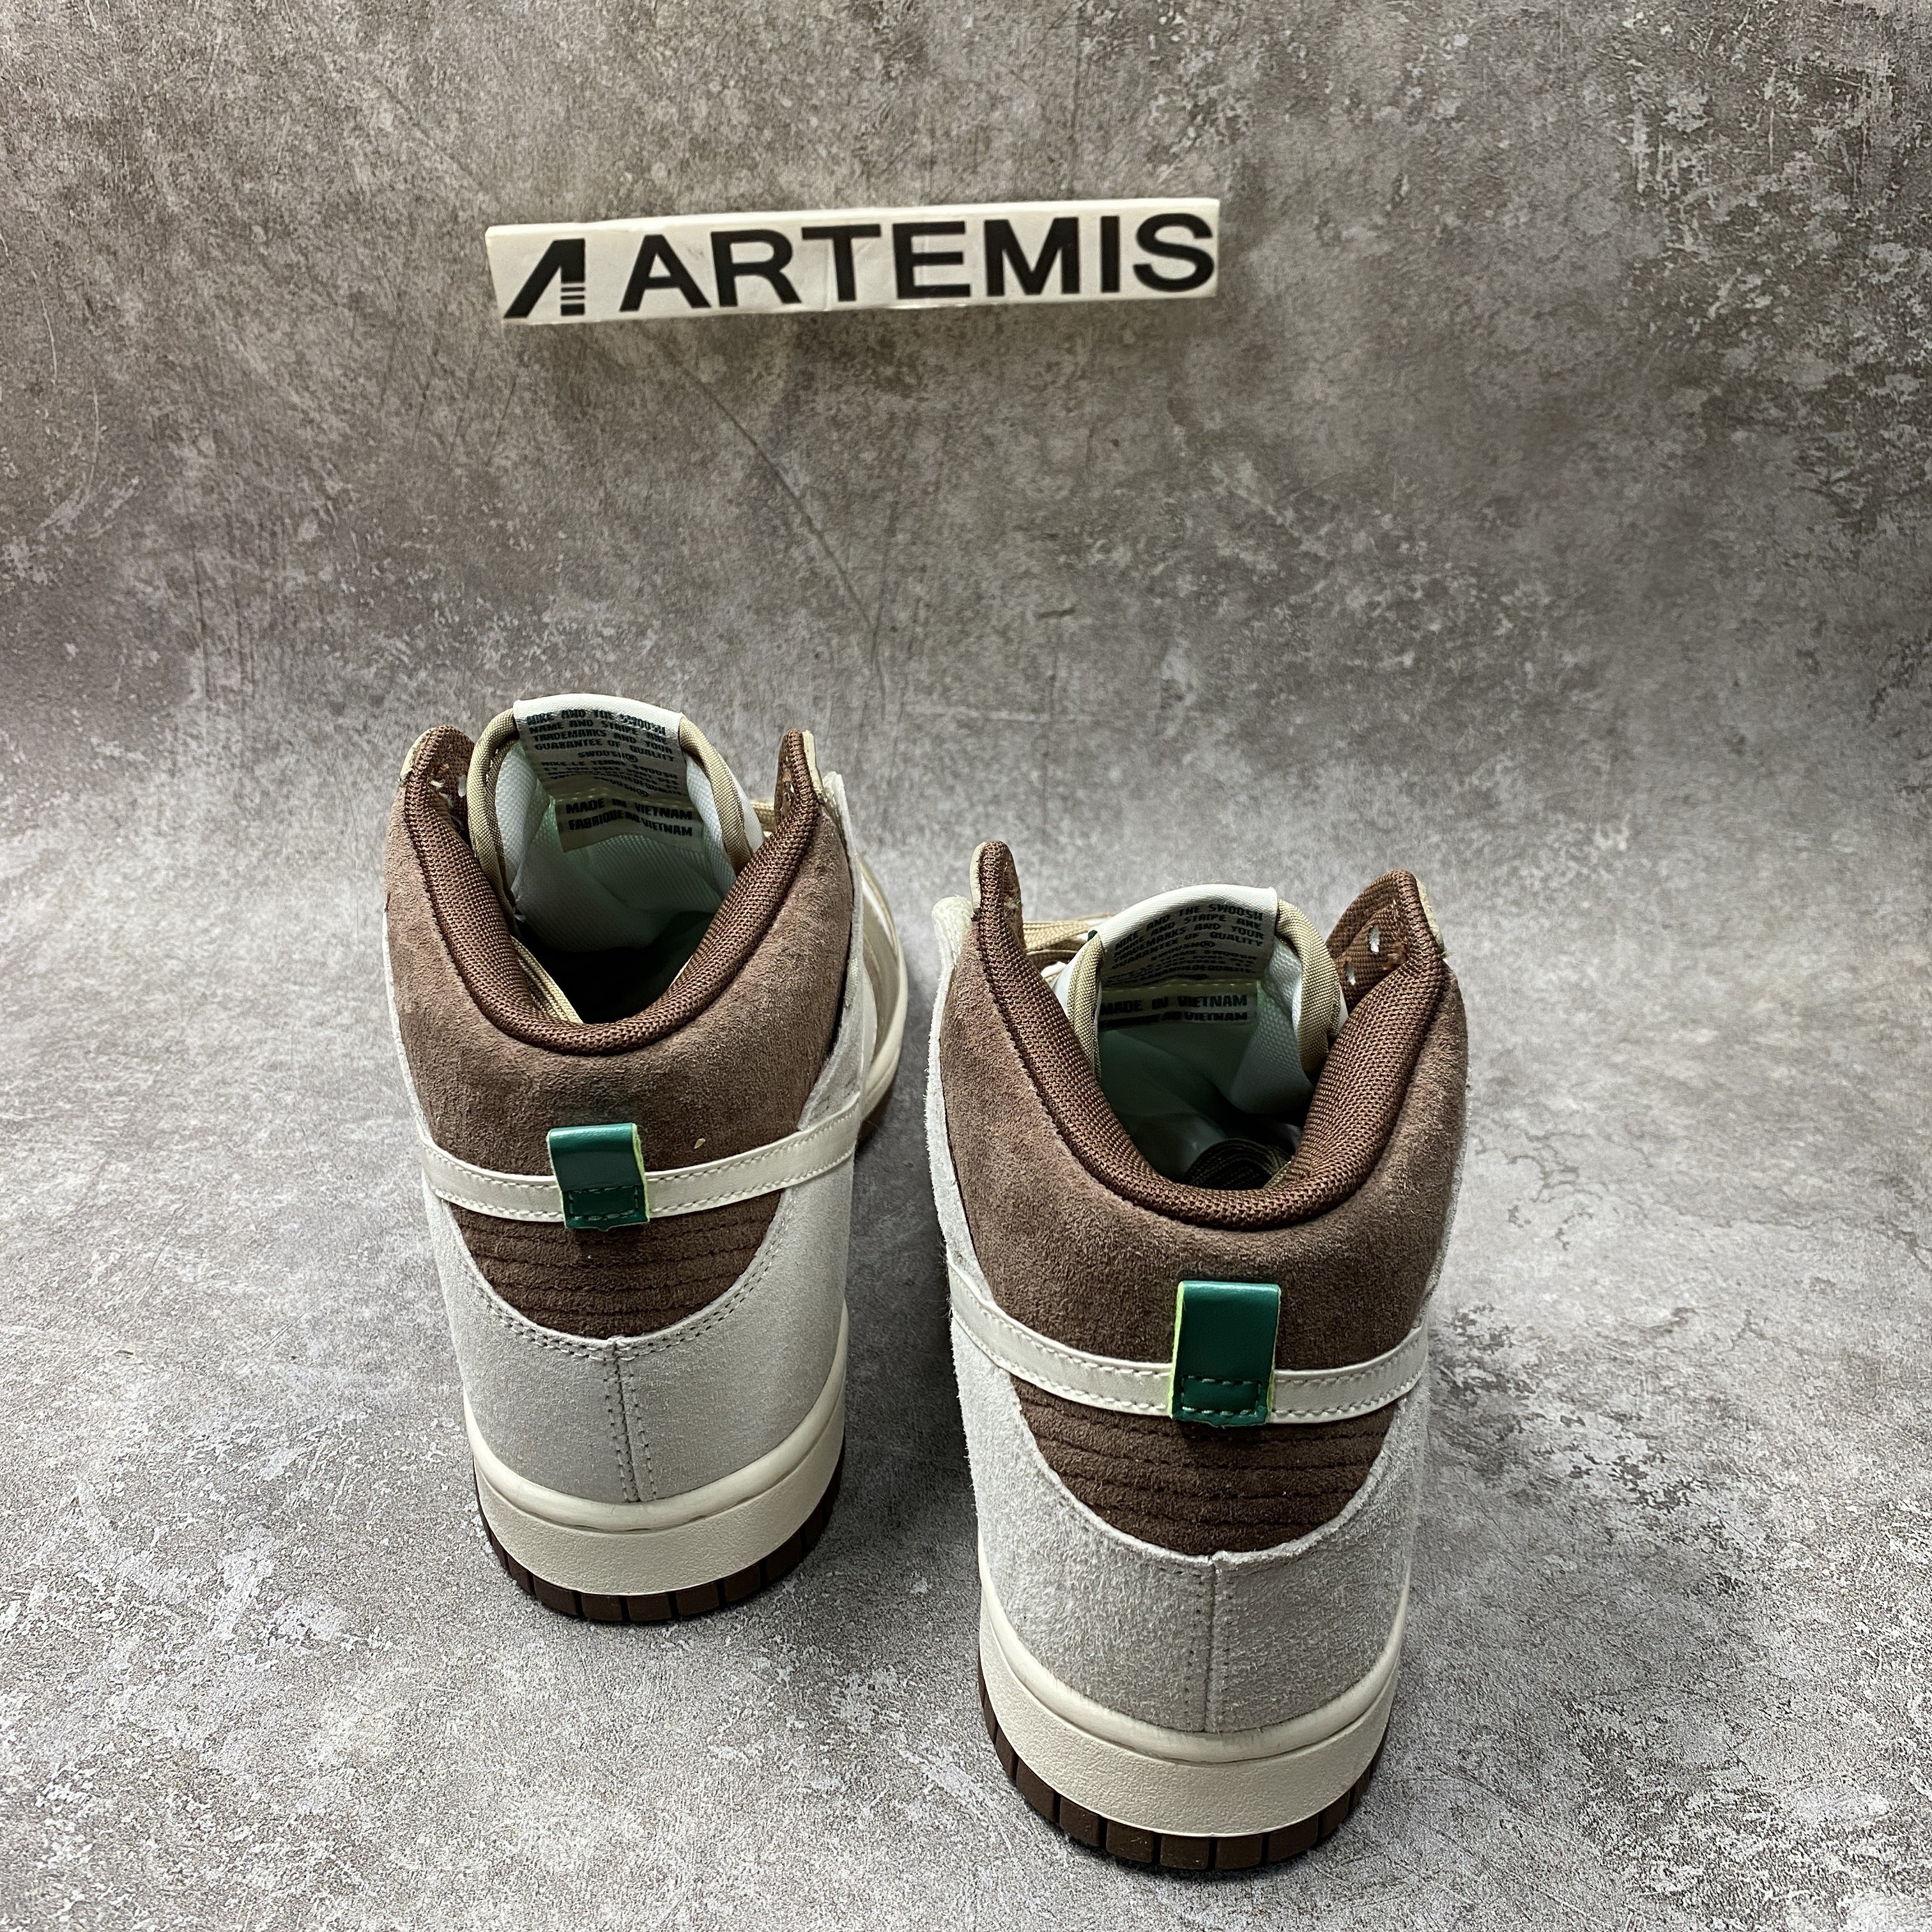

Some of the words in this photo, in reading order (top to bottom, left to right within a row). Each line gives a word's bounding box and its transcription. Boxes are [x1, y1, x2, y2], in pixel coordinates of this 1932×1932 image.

[619, 212, 1216, 312] ARTEMIS
[530, 722, 564, 733] NAME
[569, 719, 594, 728] AND
[601, 720, 638, 735] STRIPE
[532, 729, 606, 741] TRADEMARKS
[613, 733, 636, 743] AND
[645, 740, 673, 754] YOUR
[535, 739, 602, 750] GUARANTEE
[629, 745, 674, 762] QUALITY
[565, 798, 605, 814] MADE
[611, 799, 627, 808] IN
[634, 802, 692, 820] VIETNAM
[641, 817, 692, 836] VIETNAM
[1115, 930, 1140, 950] NIKE
[1146, 914, 1170, 931] AND
[1179, 905, 1202, 916] THE
[1209, 904, 1262, 921] SWOOSH
[1151, 921, 1176, 937] AND
[1184, 914, 1226, 924] STRIPE
[1236, 918, 1262, 930] ARE
[1114, 926, 1186, 963] TRADEMARKS
[1231, 925, 1264, 939] YOUR
[1210, 931, 1263, 946] QUALITY
[1100, 1000, 1142, 1016] MADE
[1151, 997, 1168, 1009] IN
[1177, 994, 1247, 1008] VIETNAM
[1184, 1012, 1247, 1022] VIETNAM
